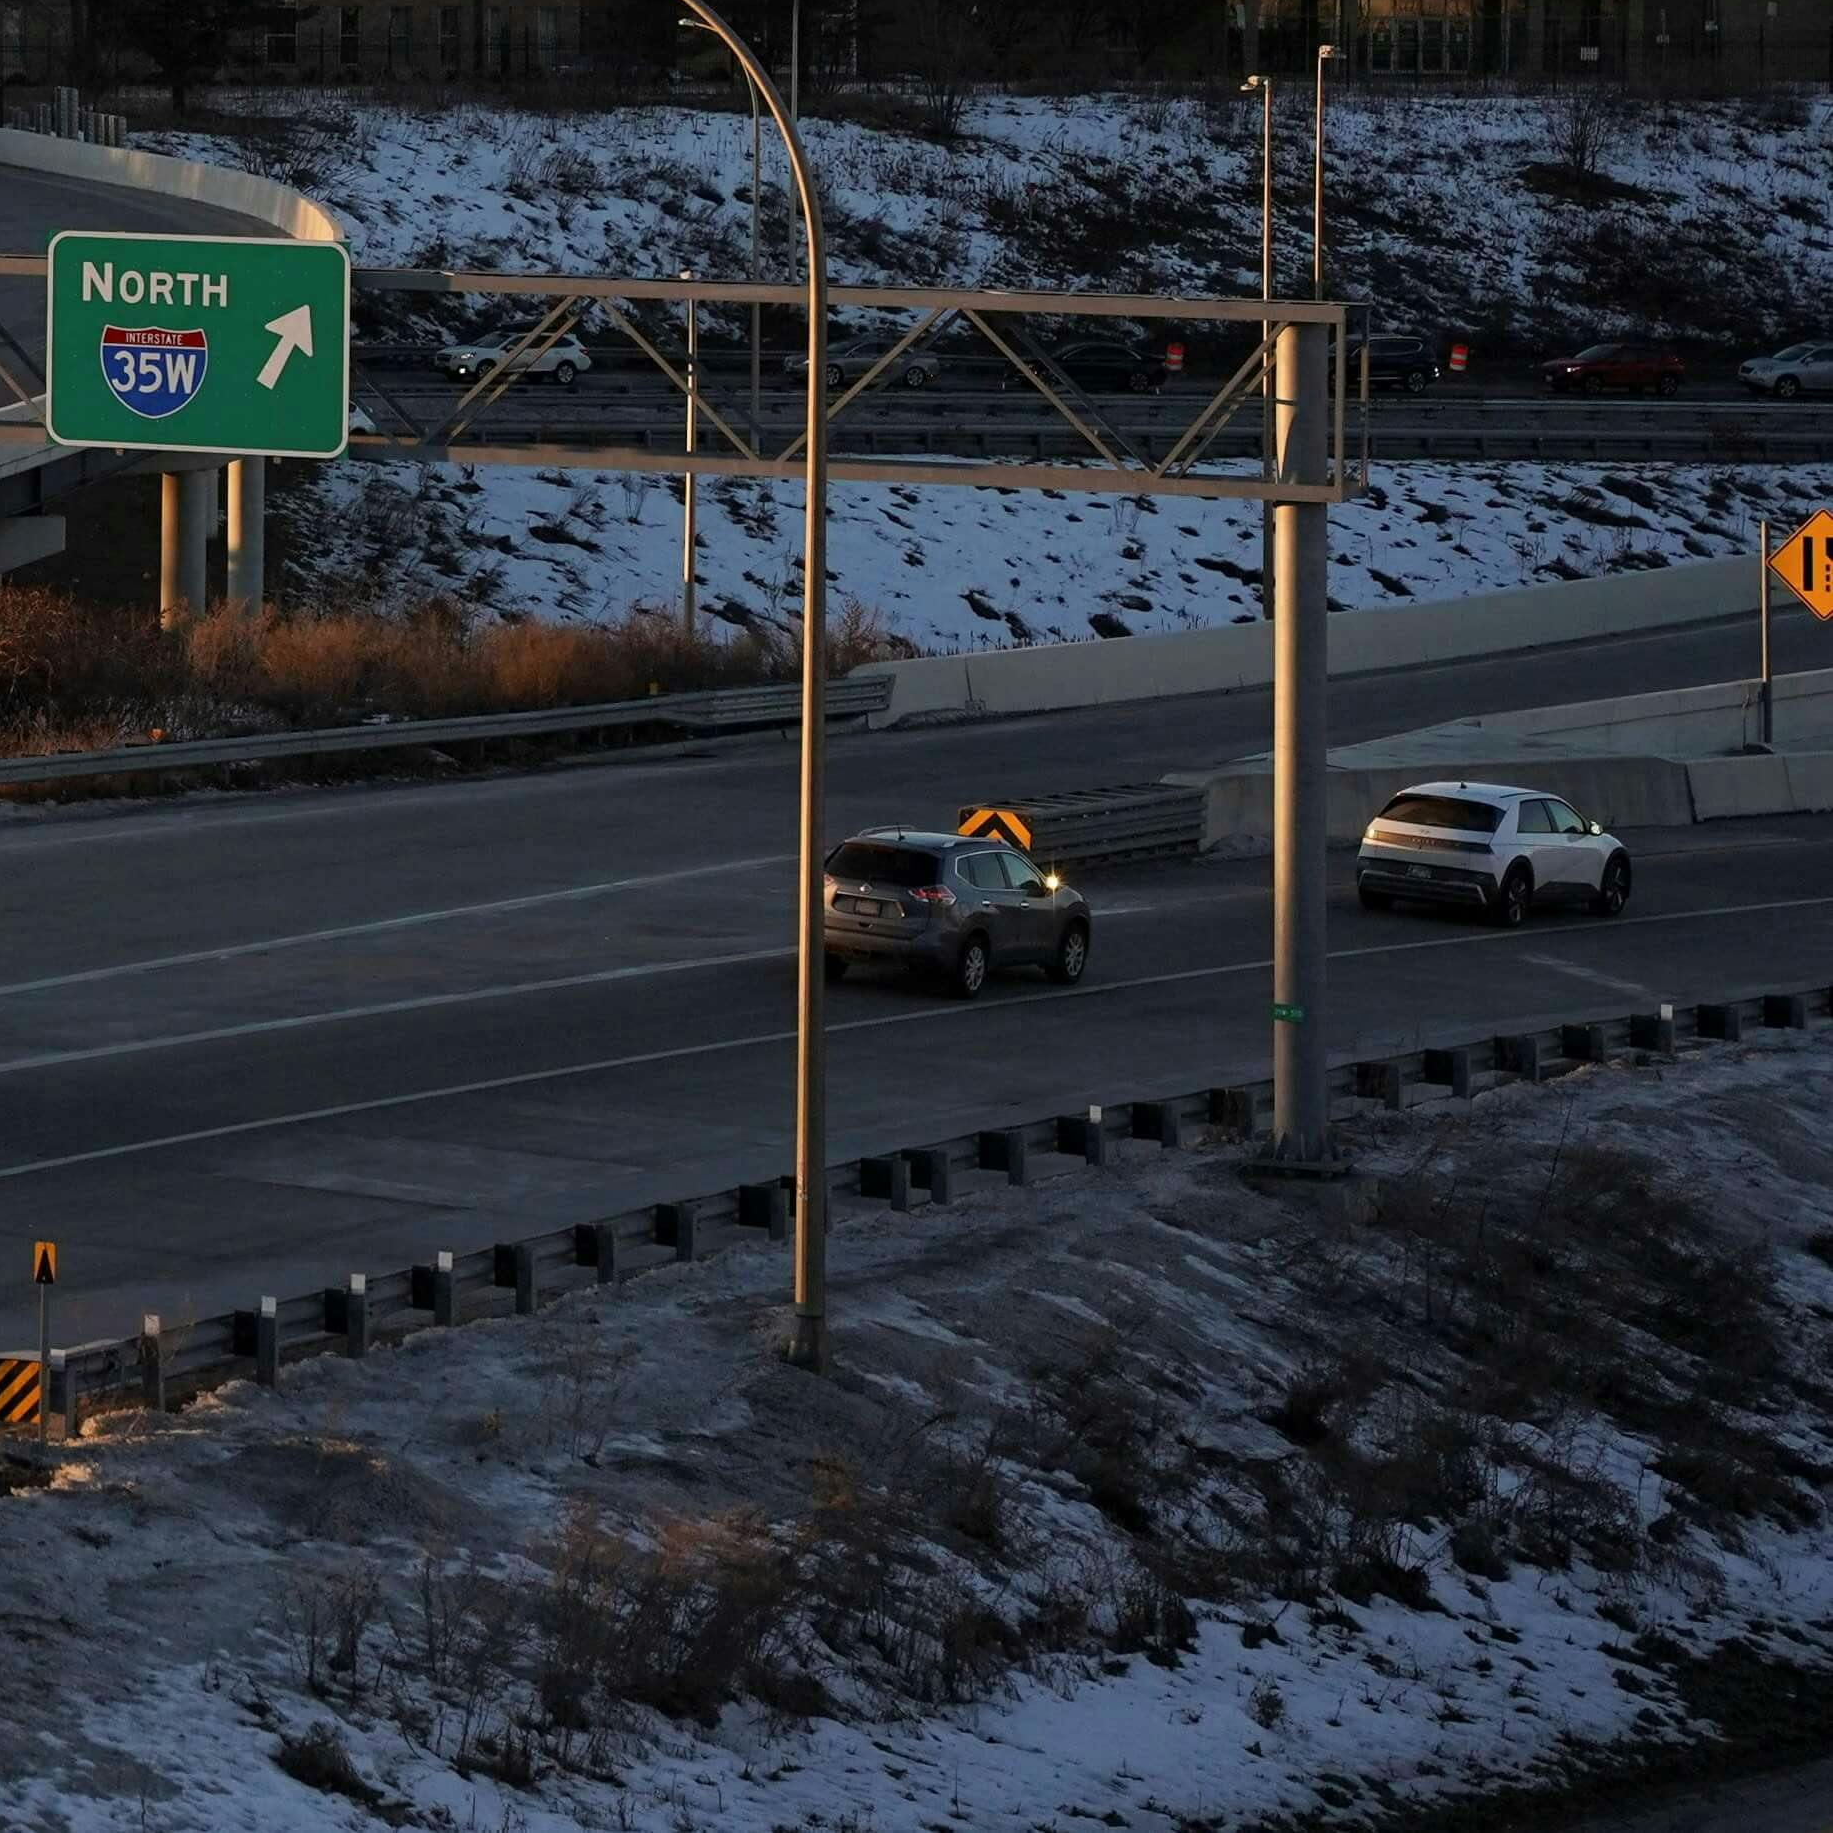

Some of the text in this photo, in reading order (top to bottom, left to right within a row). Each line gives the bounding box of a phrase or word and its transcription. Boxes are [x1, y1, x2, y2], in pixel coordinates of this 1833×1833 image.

[81, 261, 229, 308] NORTH
[125, 331, 183, 346] INTERSTATE
[111, 350, 197, 395] 35W
